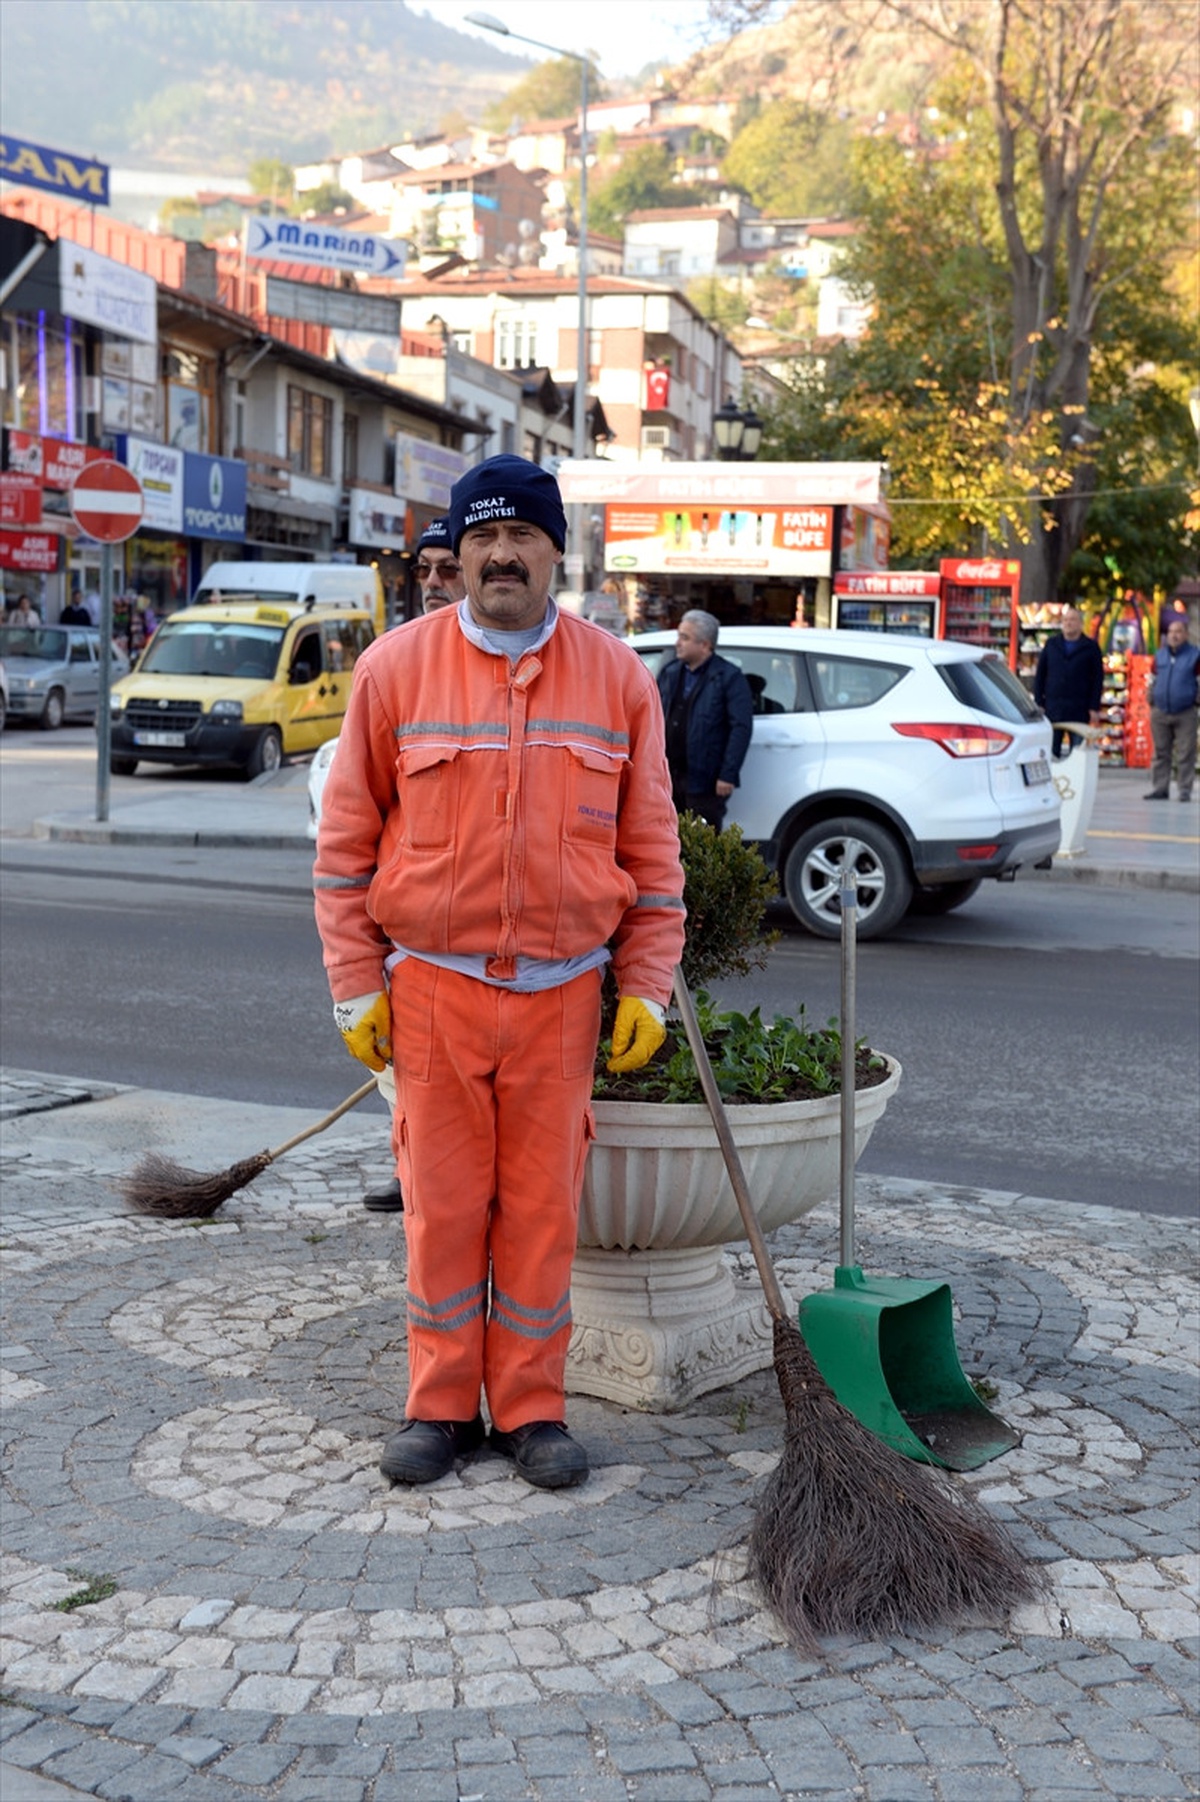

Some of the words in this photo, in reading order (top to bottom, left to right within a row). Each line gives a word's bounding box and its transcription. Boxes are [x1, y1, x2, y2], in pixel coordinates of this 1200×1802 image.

[0, 143, 104, 195] AM
[470, 496, 506, 512] TOKAT
[185, 507, 246, 534] TOPÇAM
[783, 510, 827, 528] FATİH
[784, 529, 825, 547] BÜFE
[890, 577, 926, 593] BÜFE
